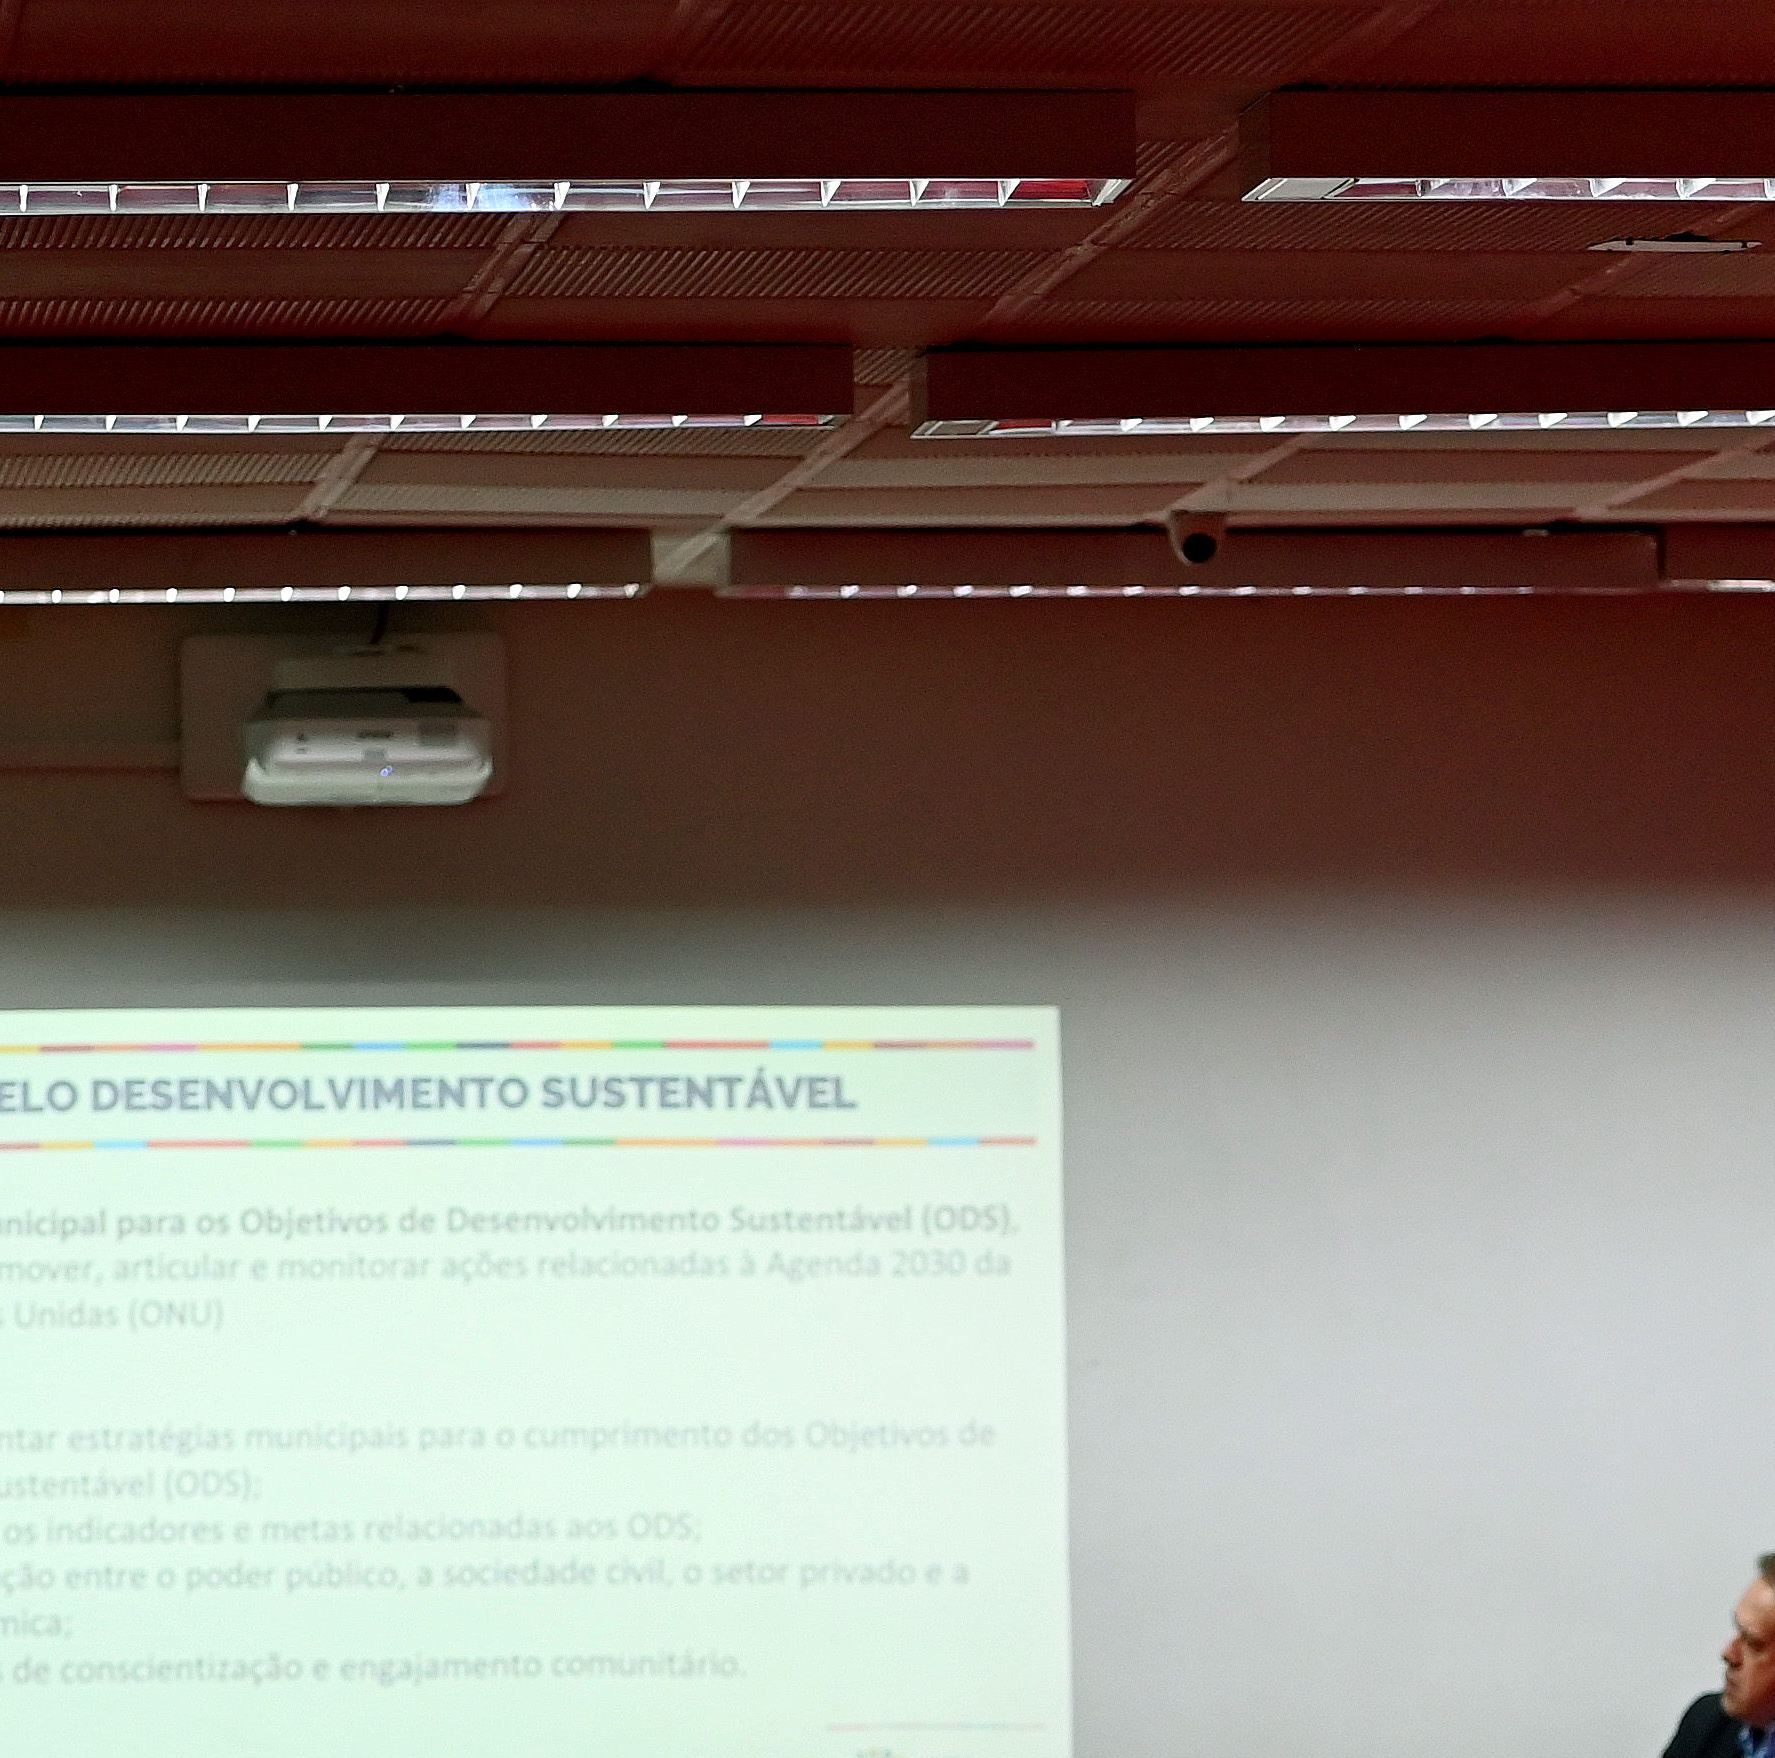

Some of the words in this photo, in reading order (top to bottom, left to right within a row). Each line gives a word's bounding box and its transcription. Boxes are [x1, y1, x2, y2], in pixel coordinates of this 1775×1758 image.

[92, 1077, 528, 1111] DESENVOLVIMENTO
[542, 1069, 855, 1108] SUSTENTÁVEL
[119, 1216, 184, 1239] para
[198, 1216, 228, 1233] os
[242, 1210, 387, 1239] Objetivos
[401, 1209, 434, 1231] de
[449, 1208, 718, 1231] Desenvolvimento
[732, 1207, 910, 1231] Sustentável
[115, 1255, 239, 1280] articular
[252, 1260, 267, 1279] e
[280, 1256, 430, 1278] monitorar
[443, 1251, 526, 1283] ações
[539, 1251, 729, 1277] relacionadas
[741, 1252, 755, 1275] à
[768, 1252, 880, 1282] Agenda
[893, 1250, 965, 1276] 2030
[976, 1250, 1010, 1274] da
[15, 1303, 117, 1327] Unidas
[130, 1301, 222, 1330] (ONU)
[70, 1426, 234, 1455] estratégias
[247, 1424, 407, 1452] municipais
[420, 1428, 485, 1451] para
[497, 1429, 514, 1447] o
[525, 1423, 731, 1451] cumprimento
[743, 1422, 794, 1447] dos
[806, 1422, 947, 1452] Objetivos
[961, 1421, 994, 1445] de
[5, 1524, 37, 1544] os
[48, 1517, 223, 1542] indicadores
[234, 1523, 249, 1542] e
[262, 1520, 354, 1541] metas
[366, 1514, 555, 1542] relacionadas
[568, 1520, 616, 1538] aos
[66, 1566, 146, 1588] entre
[158, 1569, 175, 1588] o
[187, 1562, 274, 1593] poder
[418, 1566, 432, 1586] a
[445, 1558, 596, 1585] sociedade
[684, 1565, 701, 1583] o
[713, 1562, 787, 1583] setor
[801, 1560, 914, 1587] privado
[926, 1566, 940, 1584] e
[954, 1565, 967, 1583] a
[13, 1658, 49, 1683] de
[60, 1653, 302, 1685] conscientização
[312, 1660, 328, 1680] e
[340, 1656, 540, 1685] engajamento
